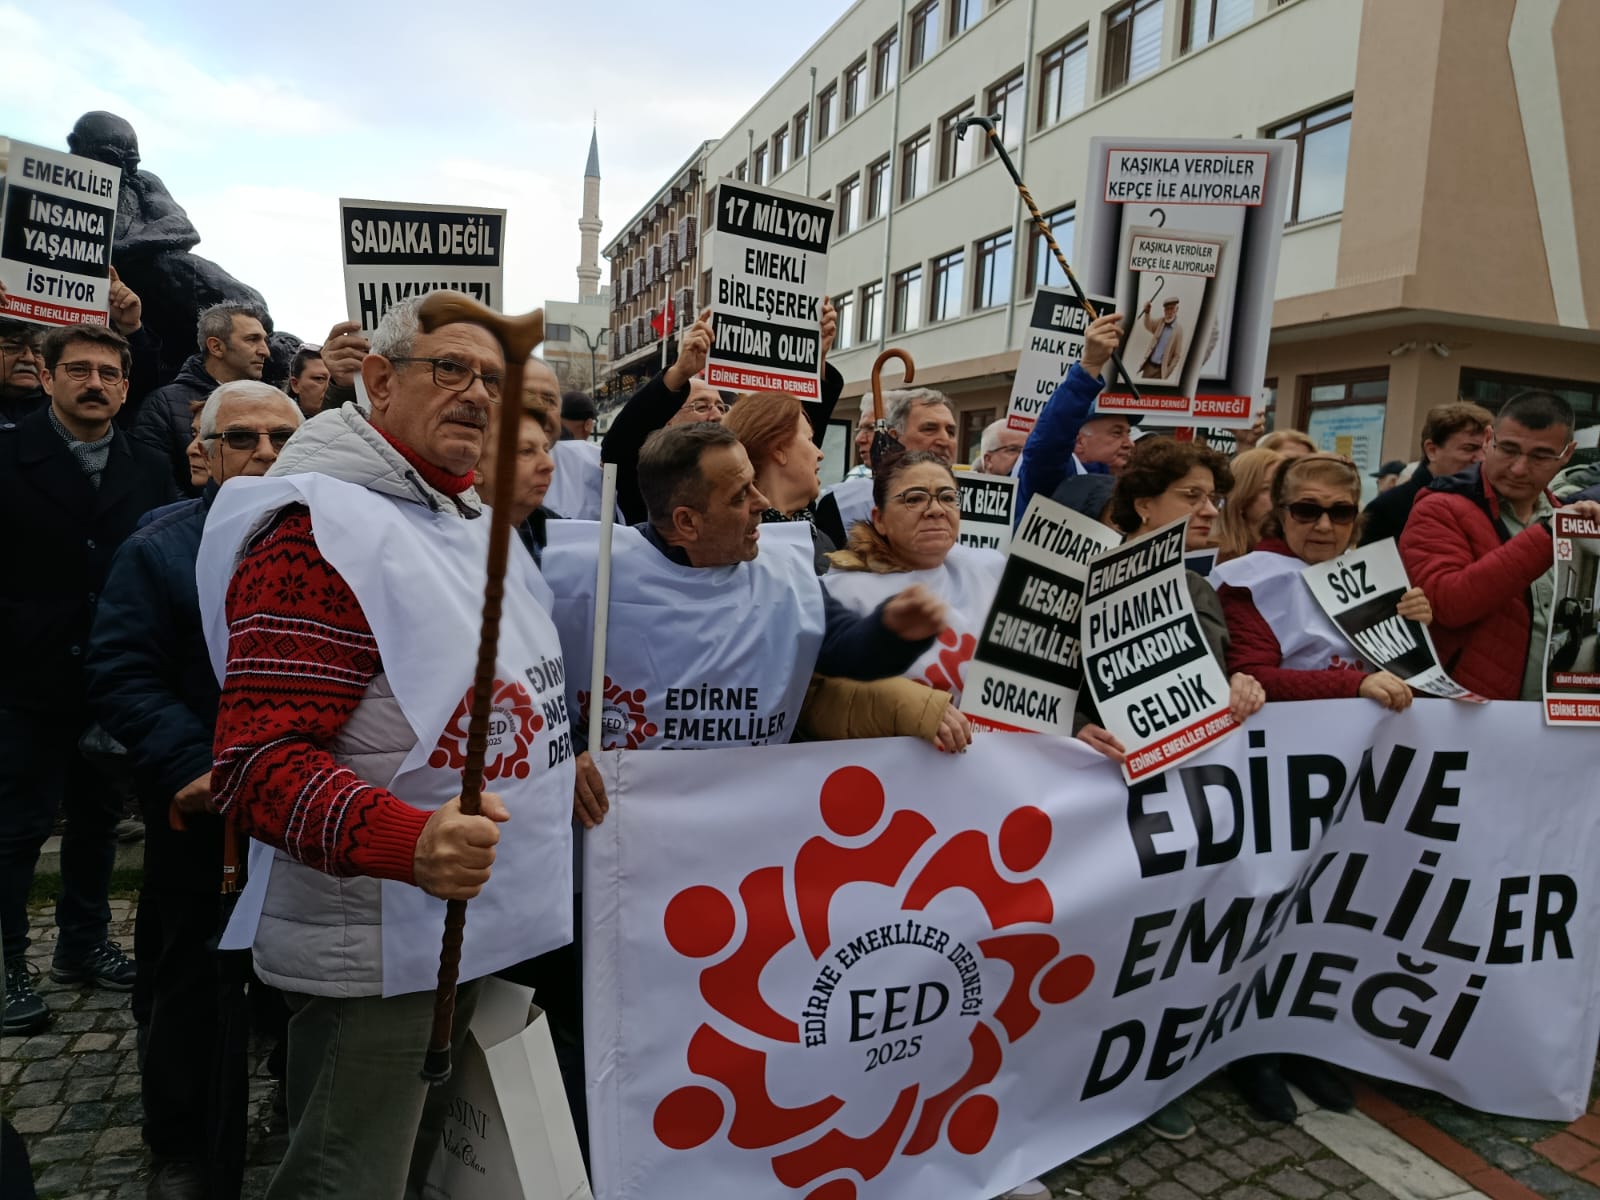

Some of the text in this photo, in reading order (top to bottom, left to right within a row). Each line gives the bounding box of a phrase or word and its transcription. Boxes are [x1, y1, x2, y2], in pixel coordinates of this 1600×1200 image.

[22, 157, 113, 200] EMEKLİLER
[1120, 155, 1255, 176] KAŞIKLA VERDİLER
[1108, 179, 1261, 200] KEPÇE İLE ALIYORLAR
[28, 194, 105, 237] İNSANCA
[725, 196, 826, 244] 17 MİLYON
[23, 227, 105, 265] YAŞAMAK
[351, 216, 495, 256] SADAKA DEĞİL
[1138, 240, 1213, 258] KAŞIKLA VERDİLER
[744, 248, 807, 285] EMEKLİ
[1131, 256, 1216, 274] KEPÇE İLE ALIYORLAR
[26, 268, 95, 303] İSTİYOR
[718, 274, 821, 322] BİRLEŞEREK
[34, 305, 80, 323] EMEKLİLER
[714, 314, 816, 366] İKTİDAR OLUR
[1031, 336, 1084, 358] HALK EK
[710, 367, 816, 395] EDİRNE EMEKLİLER DERNEĞİ
[1036, 379, 1058, 397] UC
[1014, 396, 1047, 414] KUY
[1193, 399, 1246, 415] DERNEĞİ
[974, 483, 1010, 517] BİZİZ
[1561, 517, 1600, 535] EMEKL
[1088, 531, 1182, 598] EMEKLİYİZ
[1326, 559, 1377, 605] SÖZ
[1018, 575, 1083, 624] HESABI
[1089, 577, 1184, 649] PİJAMAYI
[988, 611, 1081, 670] EMEKLİLER
[1096, 621, 1197, 693] ÇIKARDIK
[1354, 614, 1418, 665] HAKKI
[541, 694, 567, 732] EME
[665, 682, 759, 711] EDİRNE
[980, 676, 1062, 725] SORACAK
[1126, 672, 1217, 739] GELDİK
[488, 720, 507, 736] ED
[663, 711, 786, 742] EMEKLİLER
[1129, 748, 1164, 773] EDİRNE
[1163, 725, 1207, 758] EMEKLİLER
[1127, 729, 1469, 879] EDİRNE
[1112, 850, 1578, 999] EMEKLİLER
[802, 964, 843, 1049] EDİRNE
[834, 919, 951, 970] EMEKLİLER
[848, 981, 950, 1043] EED
[1079, 951, 1488, 1102] DERNEĞİ
[864, 1034, 923, 1073] 2025
